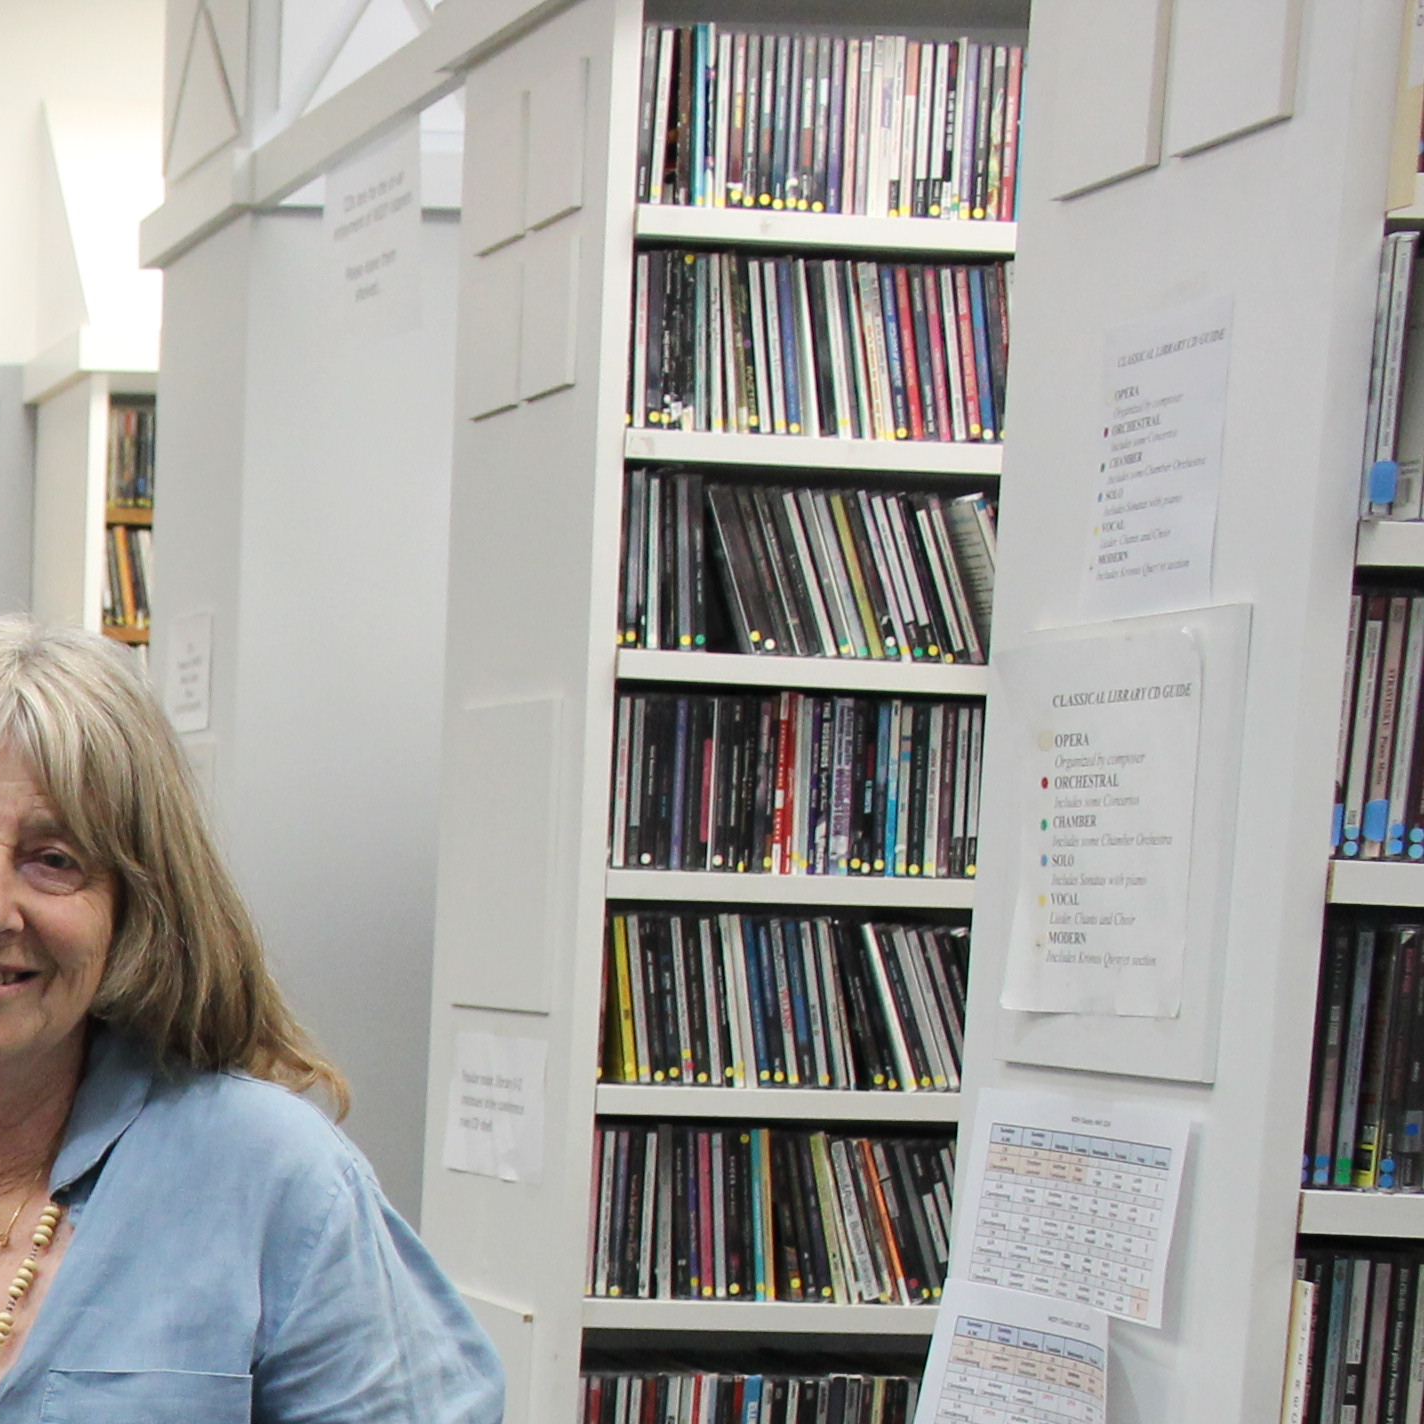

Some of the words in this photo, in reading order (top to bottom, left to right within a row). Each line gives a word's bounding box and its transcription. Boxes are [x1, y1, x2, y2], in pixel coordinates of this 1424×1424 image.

[1052, 693, 1106, 709] CLASSICAL
[1107, 687, 1146, 704] LIBRARY
[1147, 686, 1161, 700] CD
[1162, 682, 1192, 699] GUIDE
[1054, 732, 1090, 748] OPERA
[1054, 774, 1120, 790] ORCHESTRAL
[1052, 814, 1097, 829] CHAMBER
[1051, 853, 1075, 868] SOLO
[1050, 892, 1080, 907] VOCAL
[1049, 931, 1087, 945] MODERN
